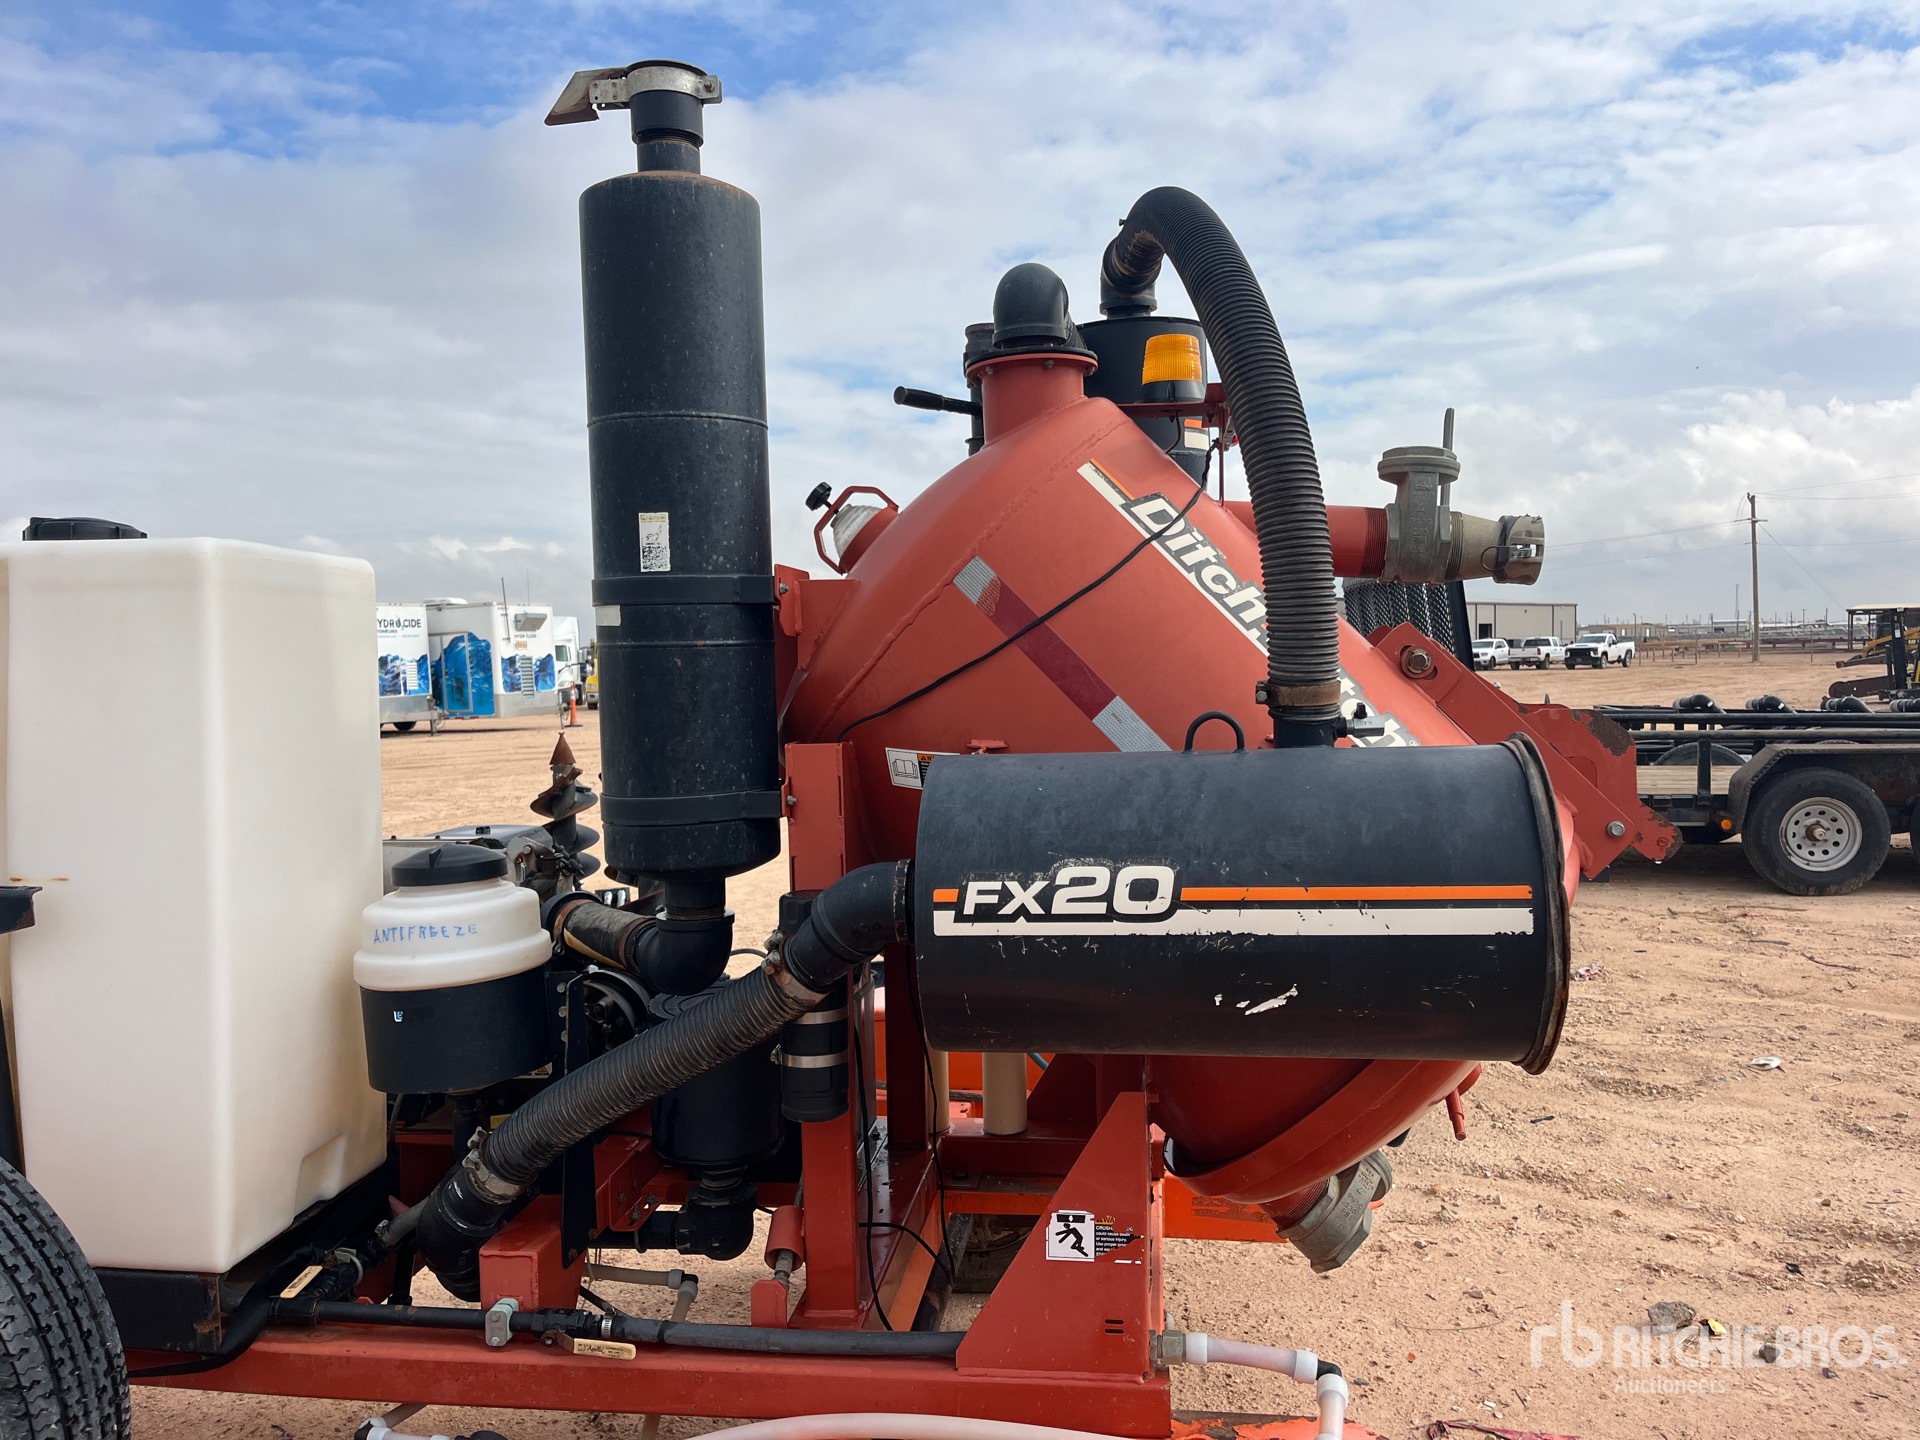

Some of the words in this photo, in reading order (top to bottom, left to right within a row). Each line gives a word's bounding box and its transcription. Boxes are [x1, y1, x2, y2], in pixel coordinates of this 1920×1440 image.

[1131, 497, 1267, 623] Ditch
[963, 866, 1175, 915] FX20
[373, 924, 478, 944] ANTIFREEZE
